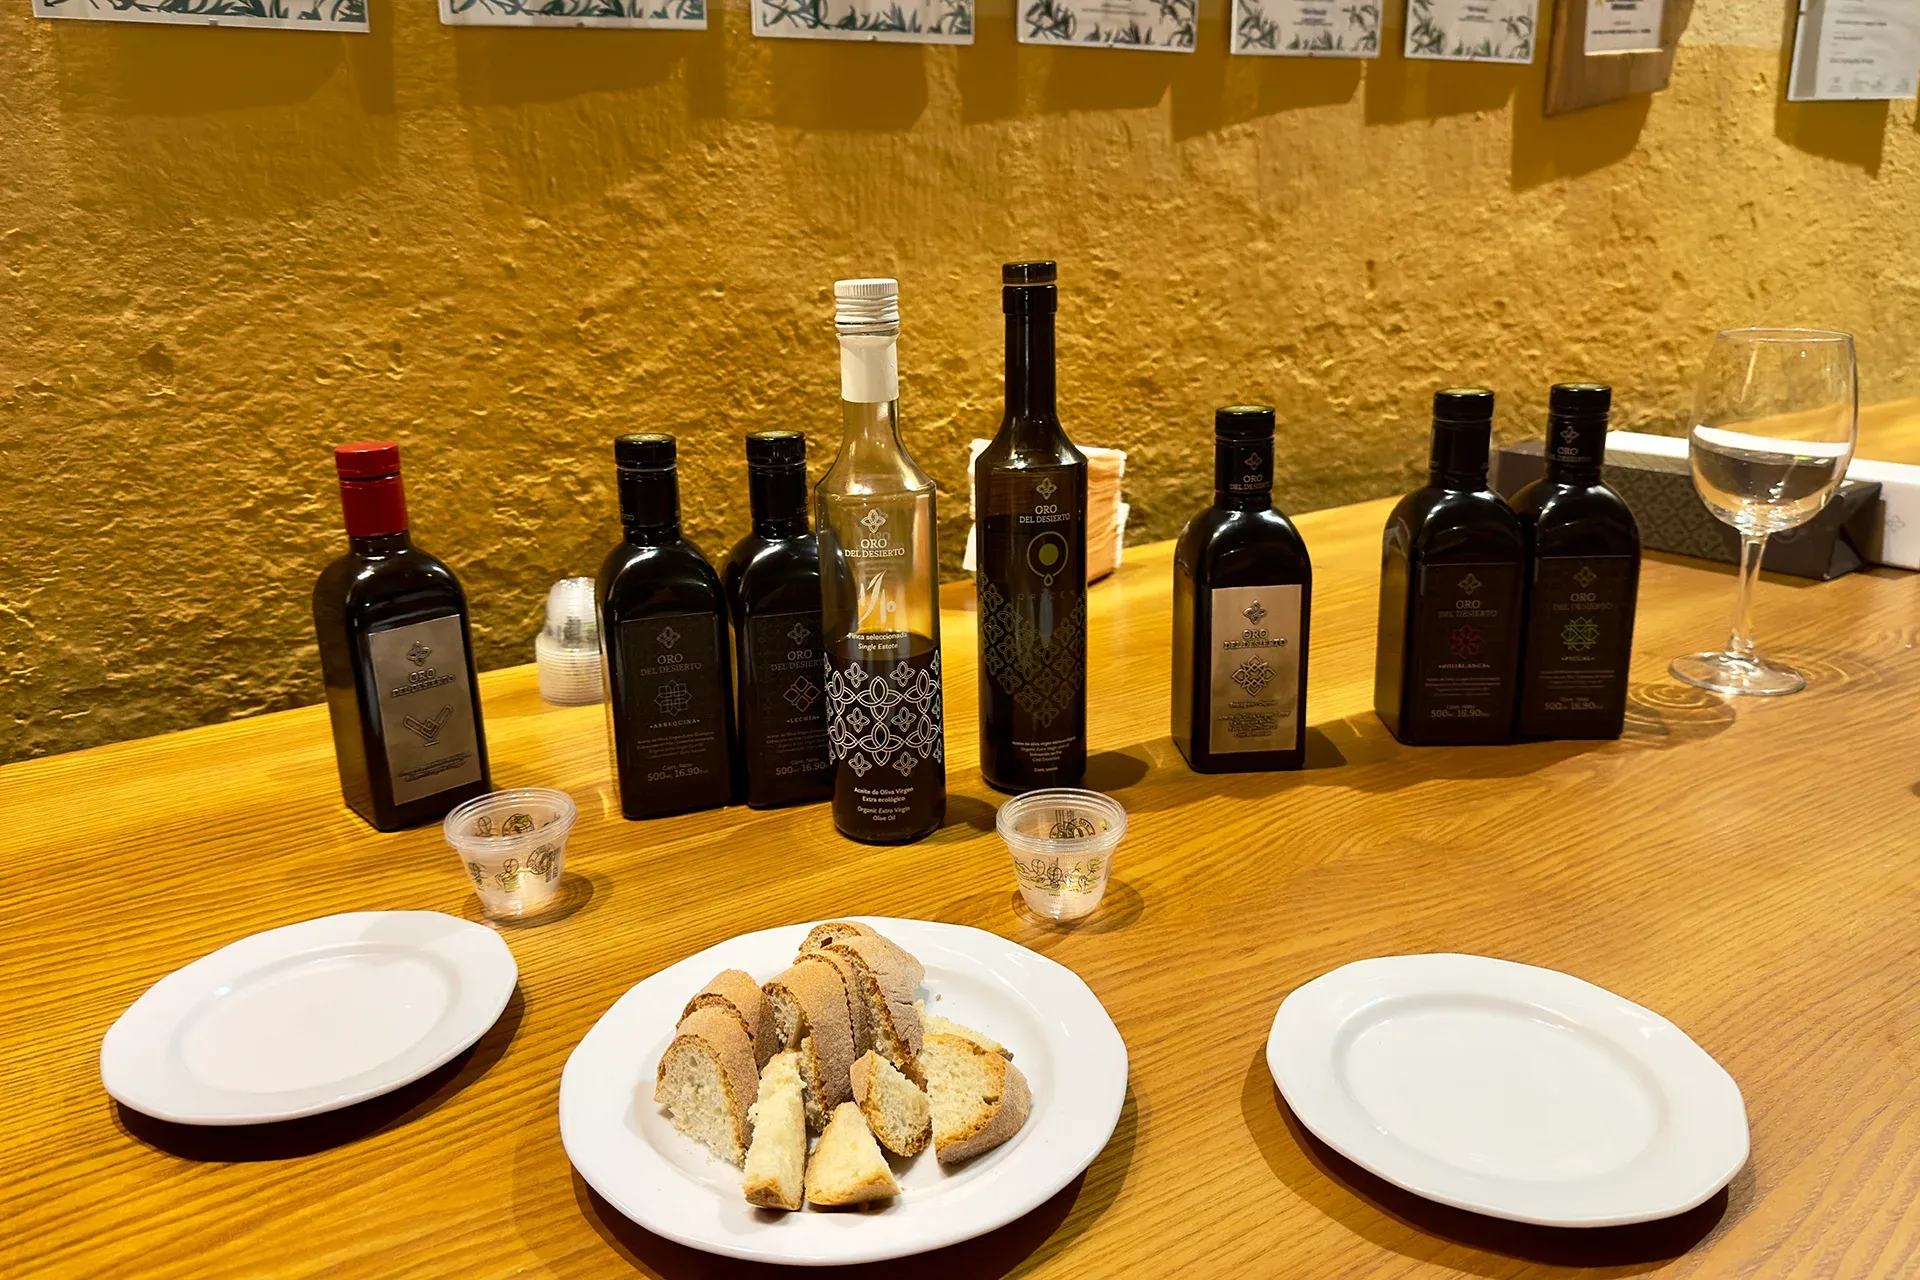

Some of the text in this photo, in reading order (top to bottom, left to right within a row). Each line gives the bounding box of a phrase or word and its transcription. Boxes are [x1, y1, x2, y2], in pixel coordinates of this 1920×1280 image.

[1557, 446, 1580, 456] ORO
[1243, 473, 1264, 483] ORO
[1035, 504, 1058, 515] ORO
[1019, 512, 1071, 524] DEL DESIERTO
[860, 538, 888, 549] ORO
[844, 547, 906, 558] DEL DESIERTO
[1570, 592, 1597, 602] ORO
[1456, 600, 1481, 610] ORO
[866, 631, 908, 640] seleccionada
[1242, 629, 1268, 640] ORO
[858, 642, 876, 652] Single
[1223, 638, 1287, 650] DEL DESIERTO
[657, 653, 684, 665] ORO
[787, 649, 813, 661] ORO
[640, 662, 702, 676] DEL DESIERTO
[789, 659, 824, 670] DESIERT
[409, 668, 437, 684] ORO
[391, 674, 456, 698] DEL DESIERTO
[854, 787, 871, 795] Aceite
[895, 787, 914, 795] Virgen
[857, 805, 877, 814] Organic
[894, 806, 911, 814] Virgin
